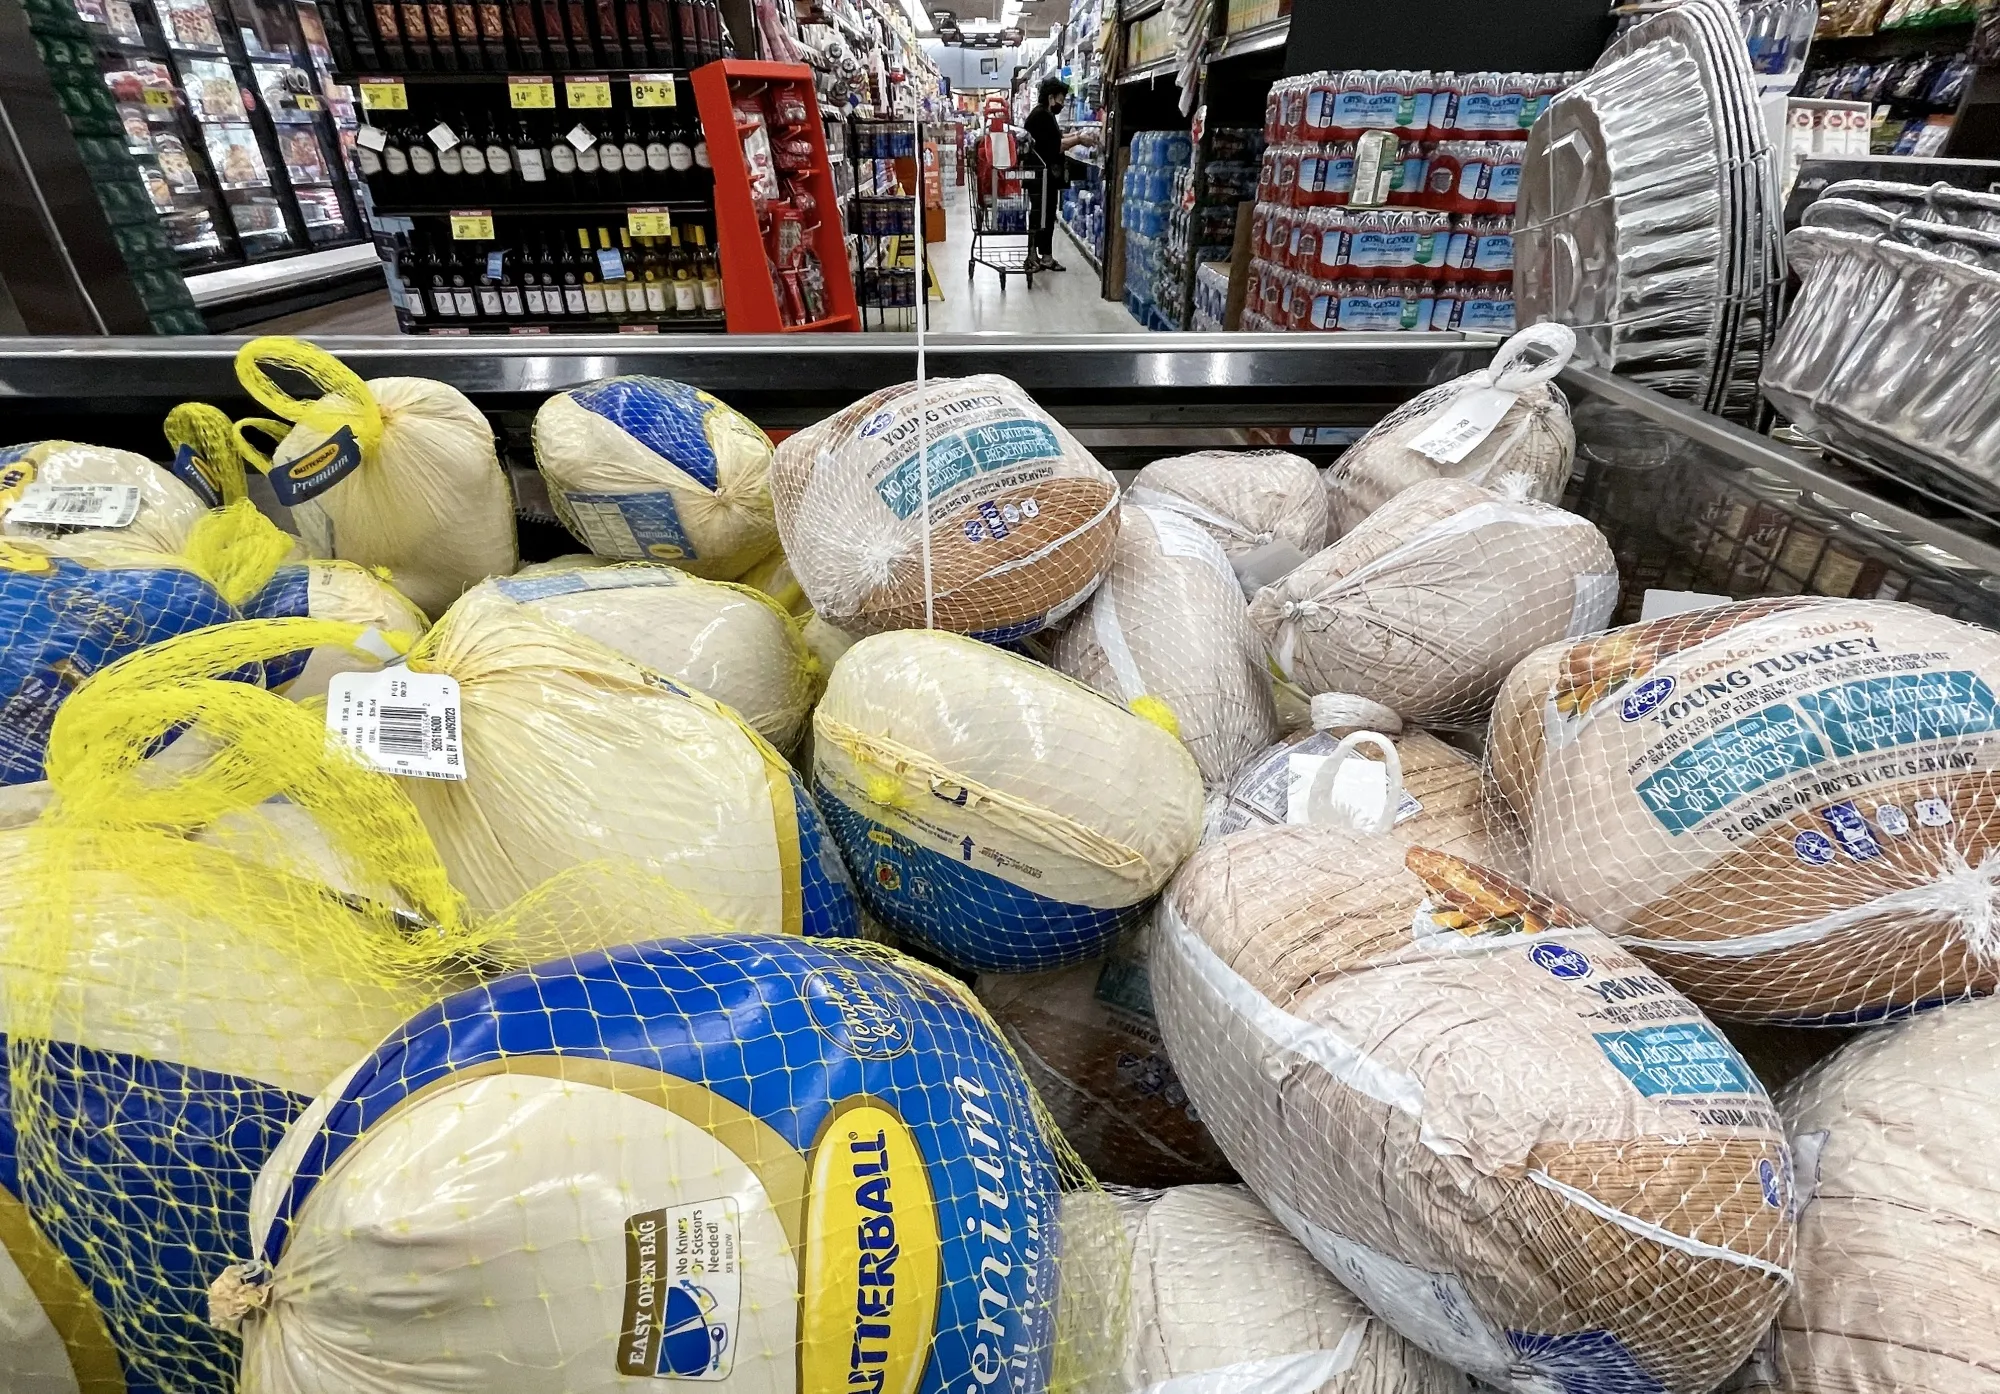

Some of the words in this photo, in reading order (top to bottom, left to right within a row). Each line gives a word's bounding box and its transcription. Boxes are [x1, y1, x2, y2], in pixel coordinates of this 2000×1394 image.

[939, 394, 1005, 416] TURKEY
[978, 425, 1000, 445] NO
[291, 453, 350, 496] Premium
[882, 478, 904, 502] NO
[1000, 475, 1017, 488] PER
[905, 488, 917, 505] OR
[442, 687, 449, 695] 21
[1652, 669, 1752, 731] YOUNG
[1748, 635, 1882, 680] TURKEY
[1828, 685, 1869, 715] NO
[1870, 683, 1963, 710] ARTIFICIAL
[1691, 715, 1706, 728] TO
[1732, 680, 1776, 706] TURKEY
[444, 707, 456, 742] Jun092023
[1841, 702, 1986, 745] PRESERVATIVES
[446, 743, 457, 753] BY
[447, 753, 459, 766] SELL
[1646, 776, 1682, 809] NO
[1681, 756, 1726, 791] ADDED
[1723, 718, 1805, 763] HORMONES
[1684, 789, 1714, 812] OR
[1708, 744, 1796, 798] STEROIDS
[1740, 795, 1794, 831] GRAMS
[1794, 787, 1811, 805] OF
[1905, 751, 1978, 775] SERVING
[1539, 950, 1580, 972] Kroger
[836, 970, 890, 1018] Juicy
[1584, 976, 1666, 1004] YOUNG
[824, 981, 879, 1054] Tender
[871, 1022, 902, 1041] &
[1605, 1041, 1643, 1069] NO
[1640, 1043, 1683, 1065] ADDED
[1647, 1066, 1675, 1089] OR
[639, 1219, 657, 1258] BAG
[675, 1216, 689, 1257] Knives
[691, 1208, 704, 1257] Scissors
[707, 1222, 721, 1274] Needed!
[724, 1233, 734, 1261] BELOW
[675, 1257, 689, 1277] No
[724, 1260, 734, 1274] SEE
[848, 1129, 900, 1394] UTTERBALL
[637, 1260, 656, 1309] OPEN
[629, 1311, 653, 1366] EASY
